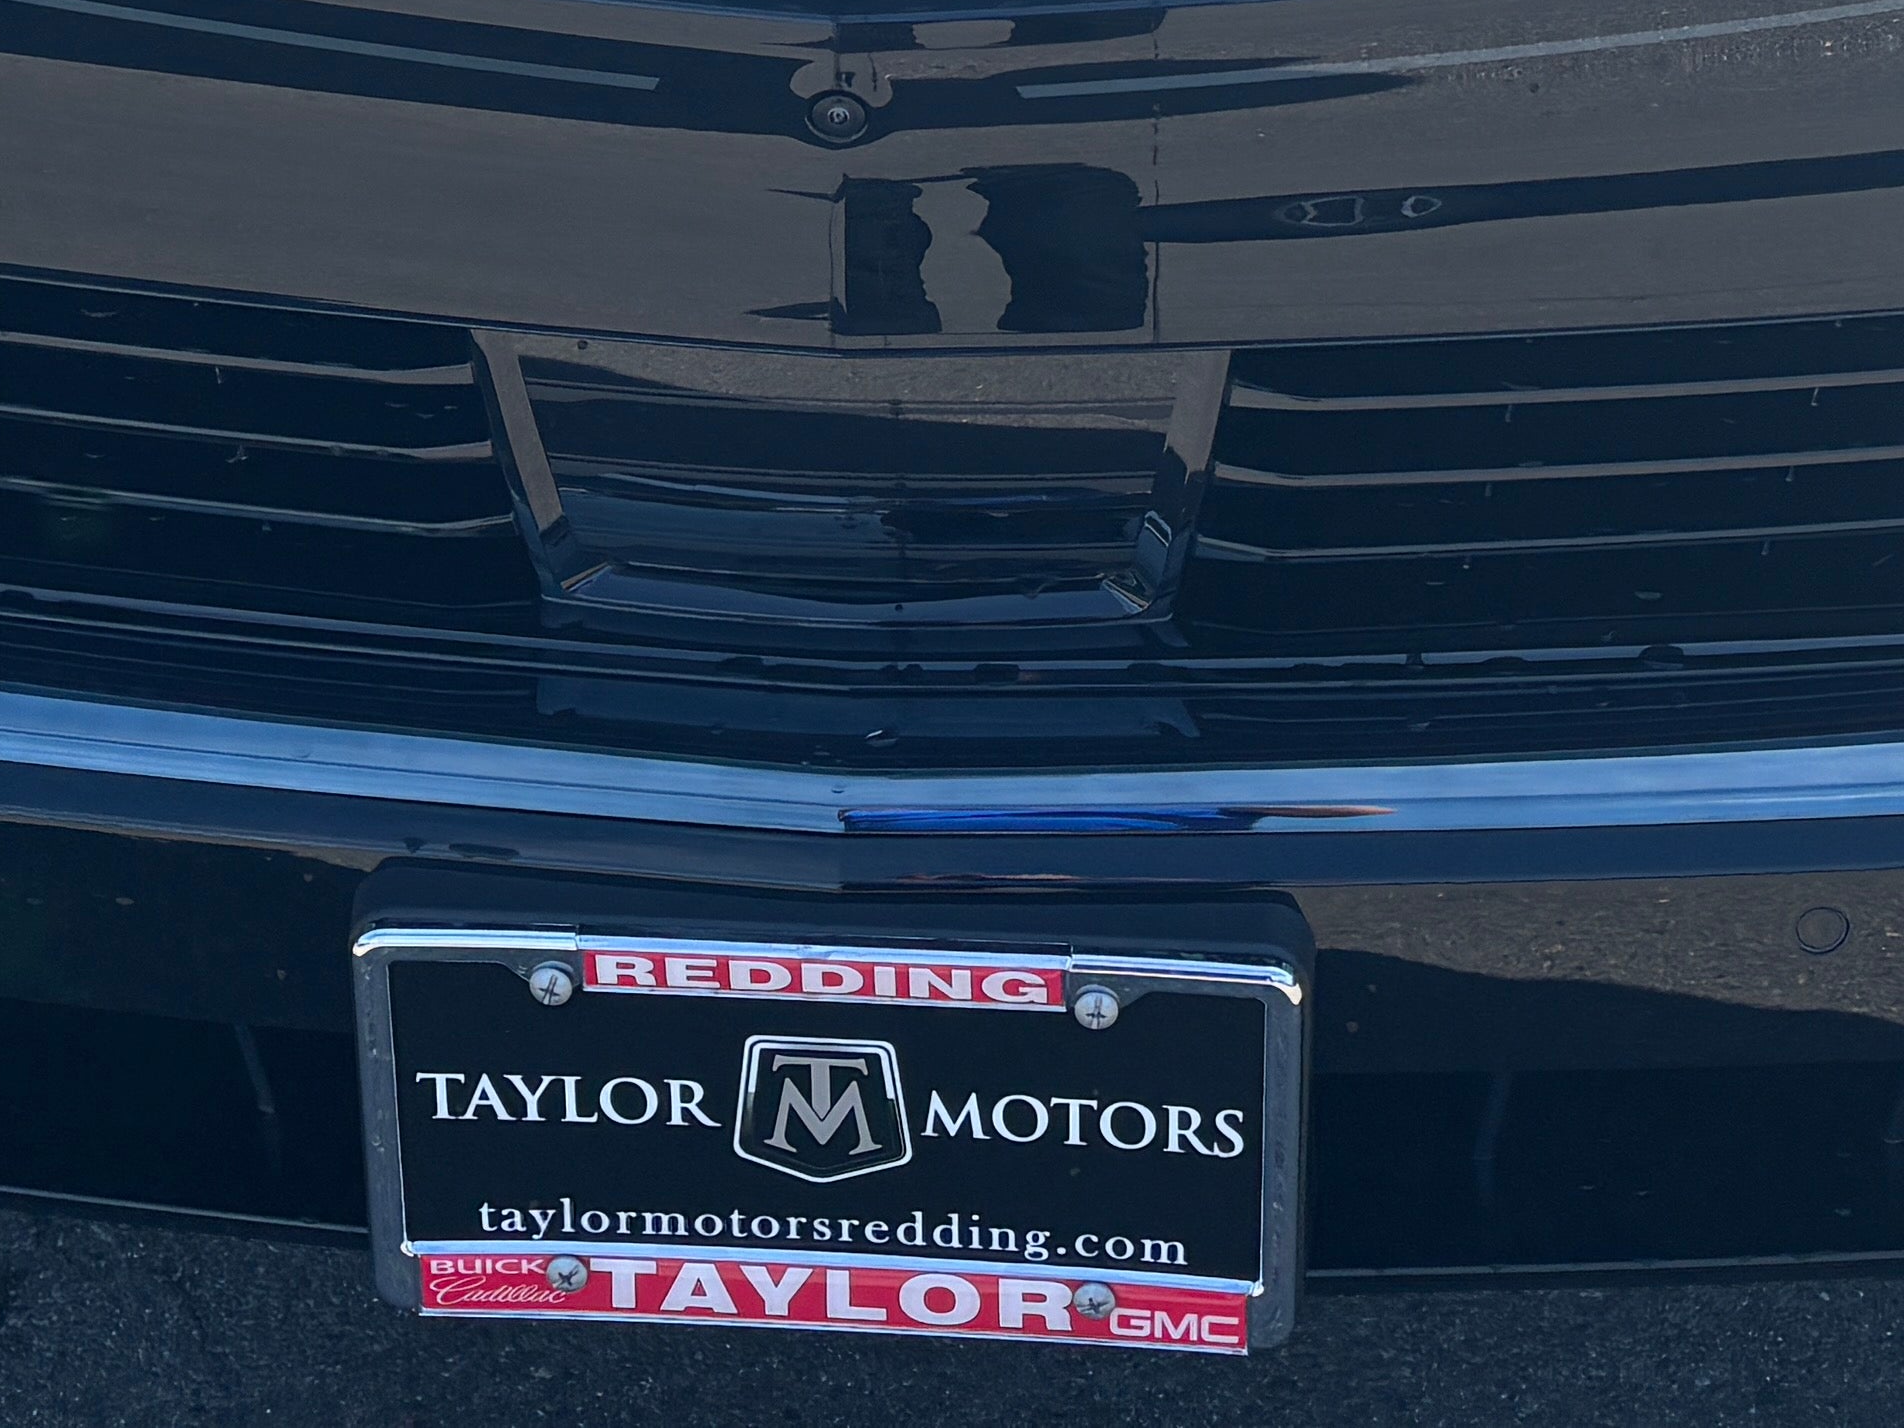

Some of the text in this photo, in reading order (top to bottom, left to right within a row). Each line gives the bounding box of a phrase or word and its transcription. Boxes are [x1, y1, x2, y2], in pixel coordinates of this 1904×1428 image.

[595, 954, 1049, 1004] REDDING
[415, 1072, 722, 1127] TAYLOR
[920, 1089, 1245, 1158] MOTORS
[478, 1197, 1188, 1266] taylormotorsredding.com
[429, 1258, 545, 1275] BUICK
[430, 1275, 566, 1306] Cadillac
[588, 1257, 1074, 1332] TAYLOR
[1109, 1307, 1240, 1344] GMC
